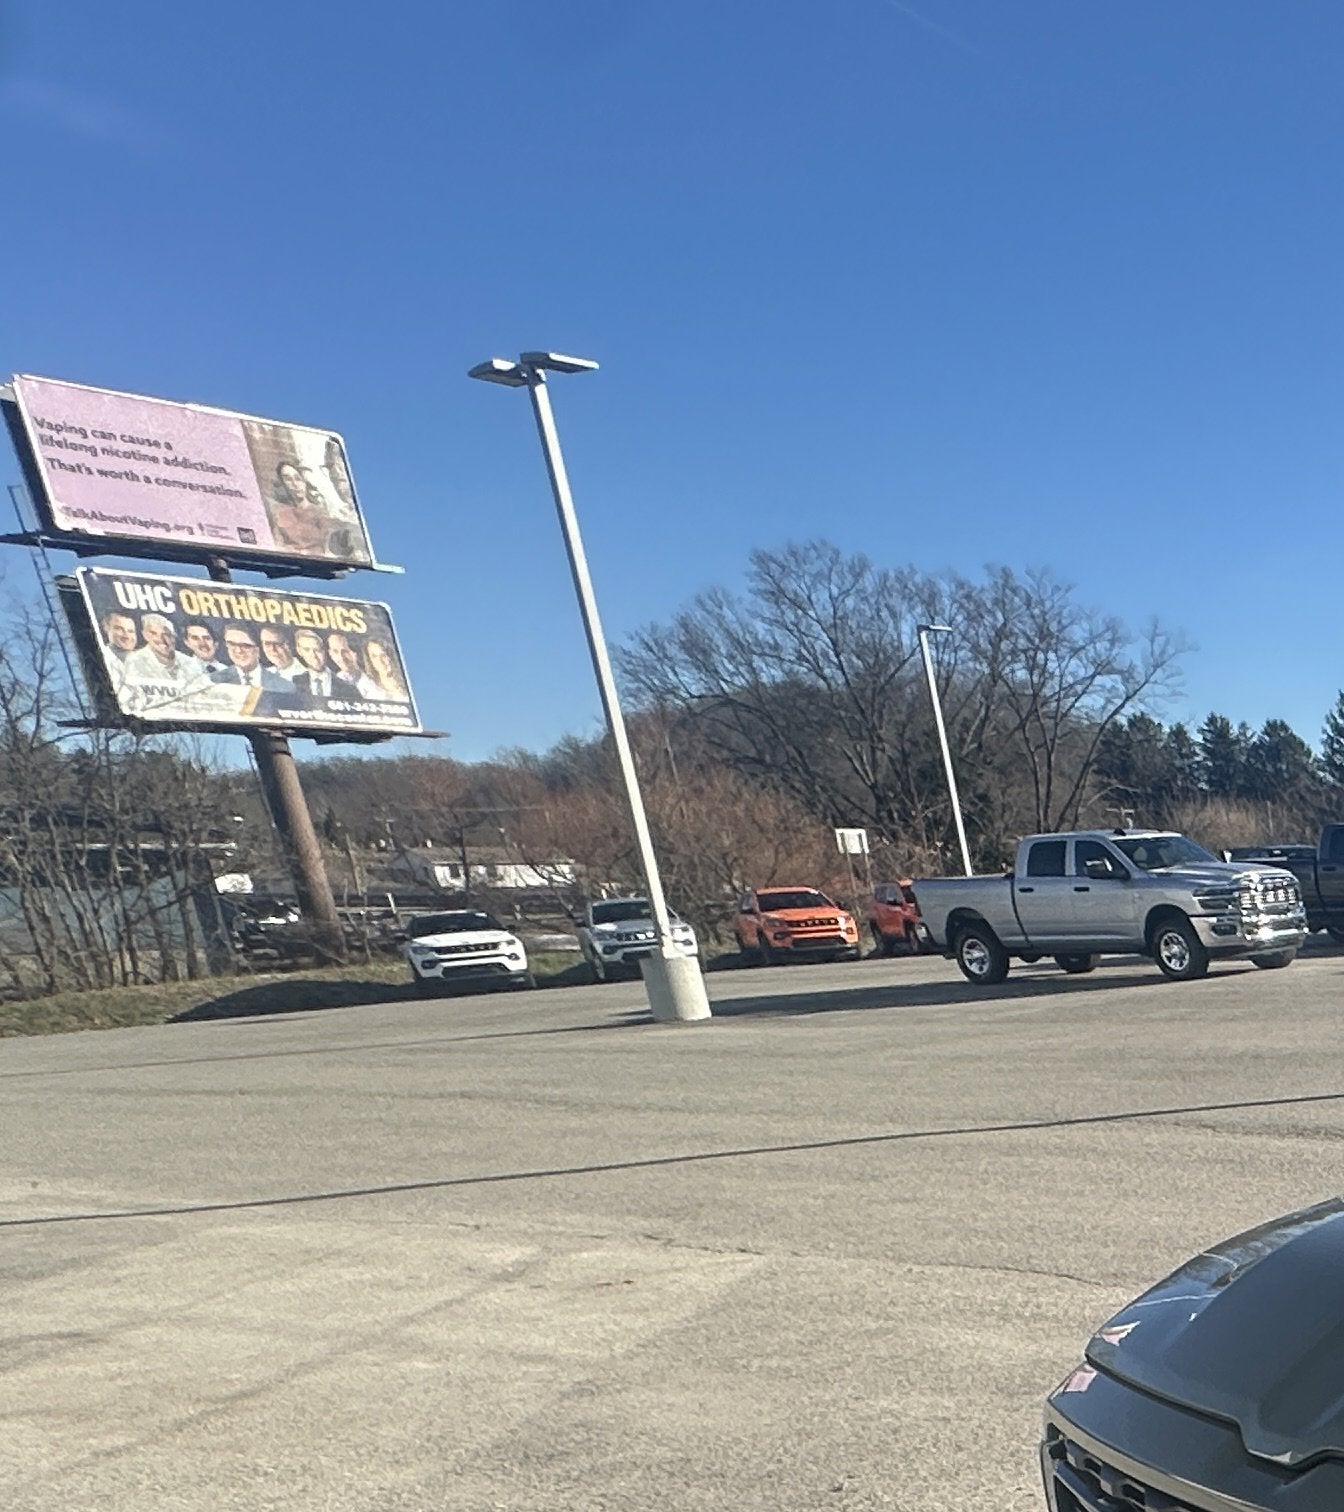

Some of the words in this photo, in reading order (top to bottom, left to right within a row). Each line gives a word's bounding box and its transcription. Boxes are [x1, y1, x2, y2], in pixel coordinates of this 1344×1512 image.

[33, 416, 88, 439] Vaping
[91, 429, 117, 441] can
[120, 433, 161, 449] cause
[164, 441, 172, 451] a
[38, 434, 98, 457] lifelong
[100, 446, 159, 464] nicotine
[163, 455, 230, 476] addiction.
[46, 457, 93, 475] That's
[96, 468, 141, 483] worth
[143, 475, 152, 484] a
[155, 477, 248, 499] conversation.
[112, 580, 176, 614] UHC
[178, 588, 368, 634] ORTHOPAEDICS
[140, 684, 177, 698] WVU
